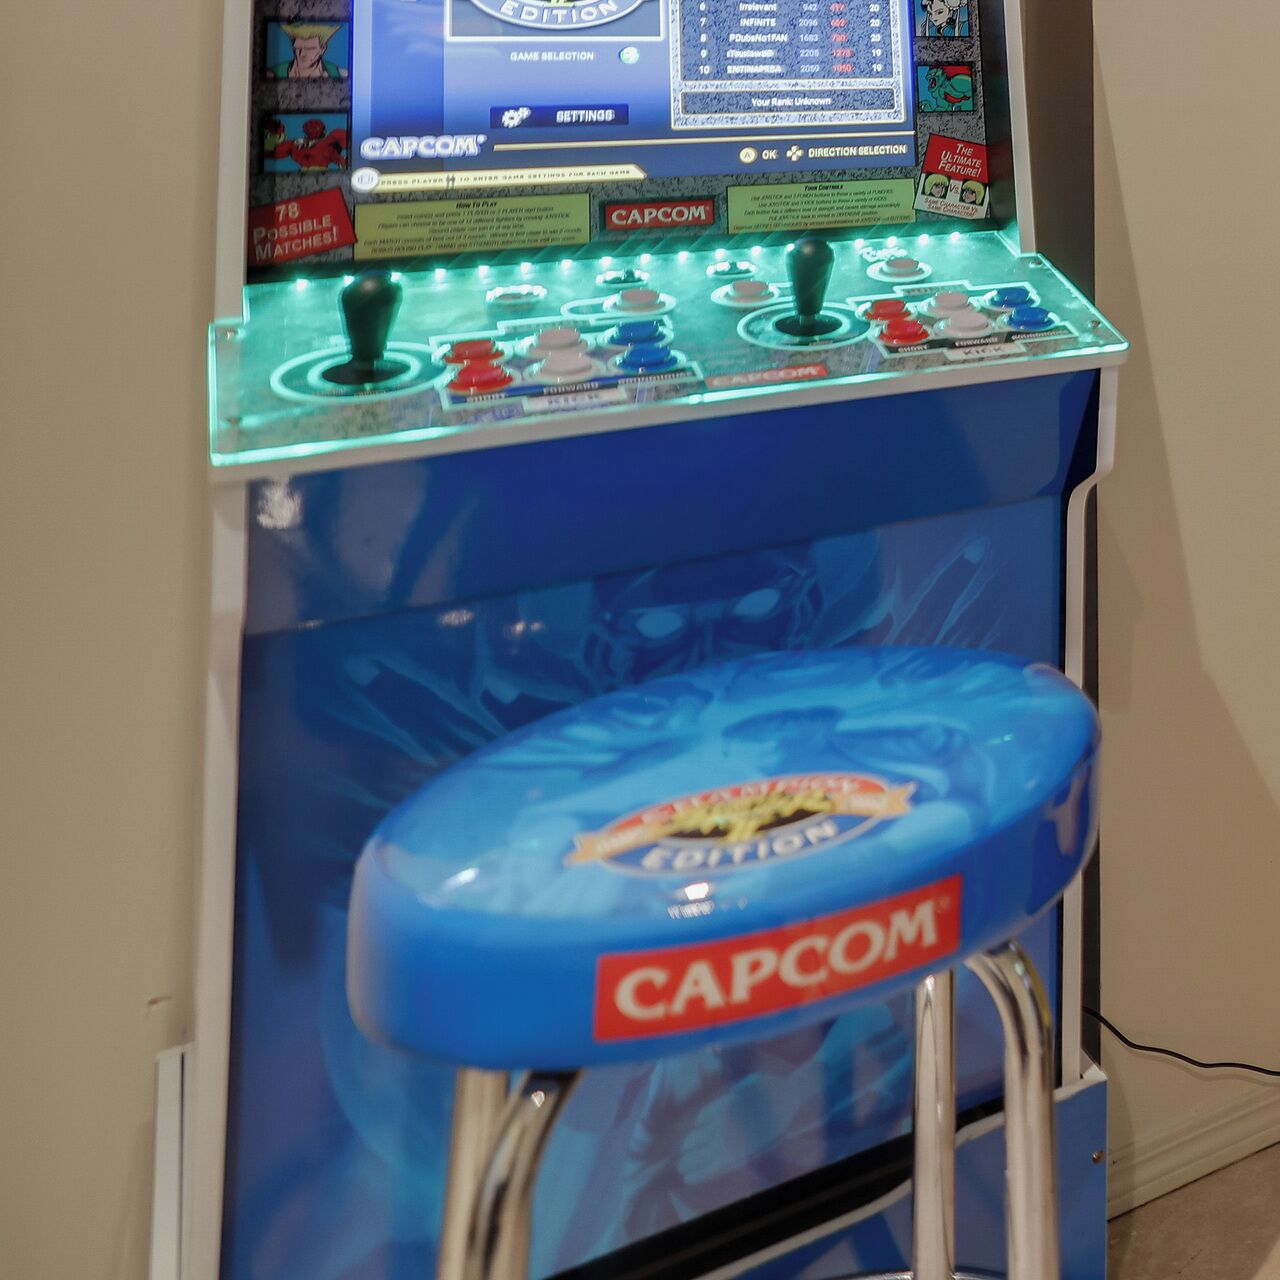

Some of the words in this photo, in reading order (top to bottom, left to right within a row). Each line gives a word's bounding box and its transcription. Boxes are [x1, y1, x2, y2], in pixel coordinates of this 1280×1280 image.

[500, 0, 618, 23] EDITION
[510, 51, 539, 62] GAME
[541, 51, 595, 62] SELECTION
[752, 98, 771, 107] Your
[772, 97, 794, 106] Rank:
[795, 96, 831, 106] Unknown
[556, 109, 615, 122] SETTINGS
[762, 149, 777, 160] OK
[808, 145, 856, 159] DIRECTION
[858, 143, 907, 156] SELECTION
[956, 144, 973, 156] THE
[941, 151, 982, 168] ULTIMATE
[938, 161, 982, 177] FEATURE!
[275, 202, 299, 223] 78
[253, 214, 331, 243] POSSIBLE
[255, 226, 338, 260] MATCHES!
[641, 819, 838, 871] EDITION
[614, 898, 940, 1021] CAPCOM
